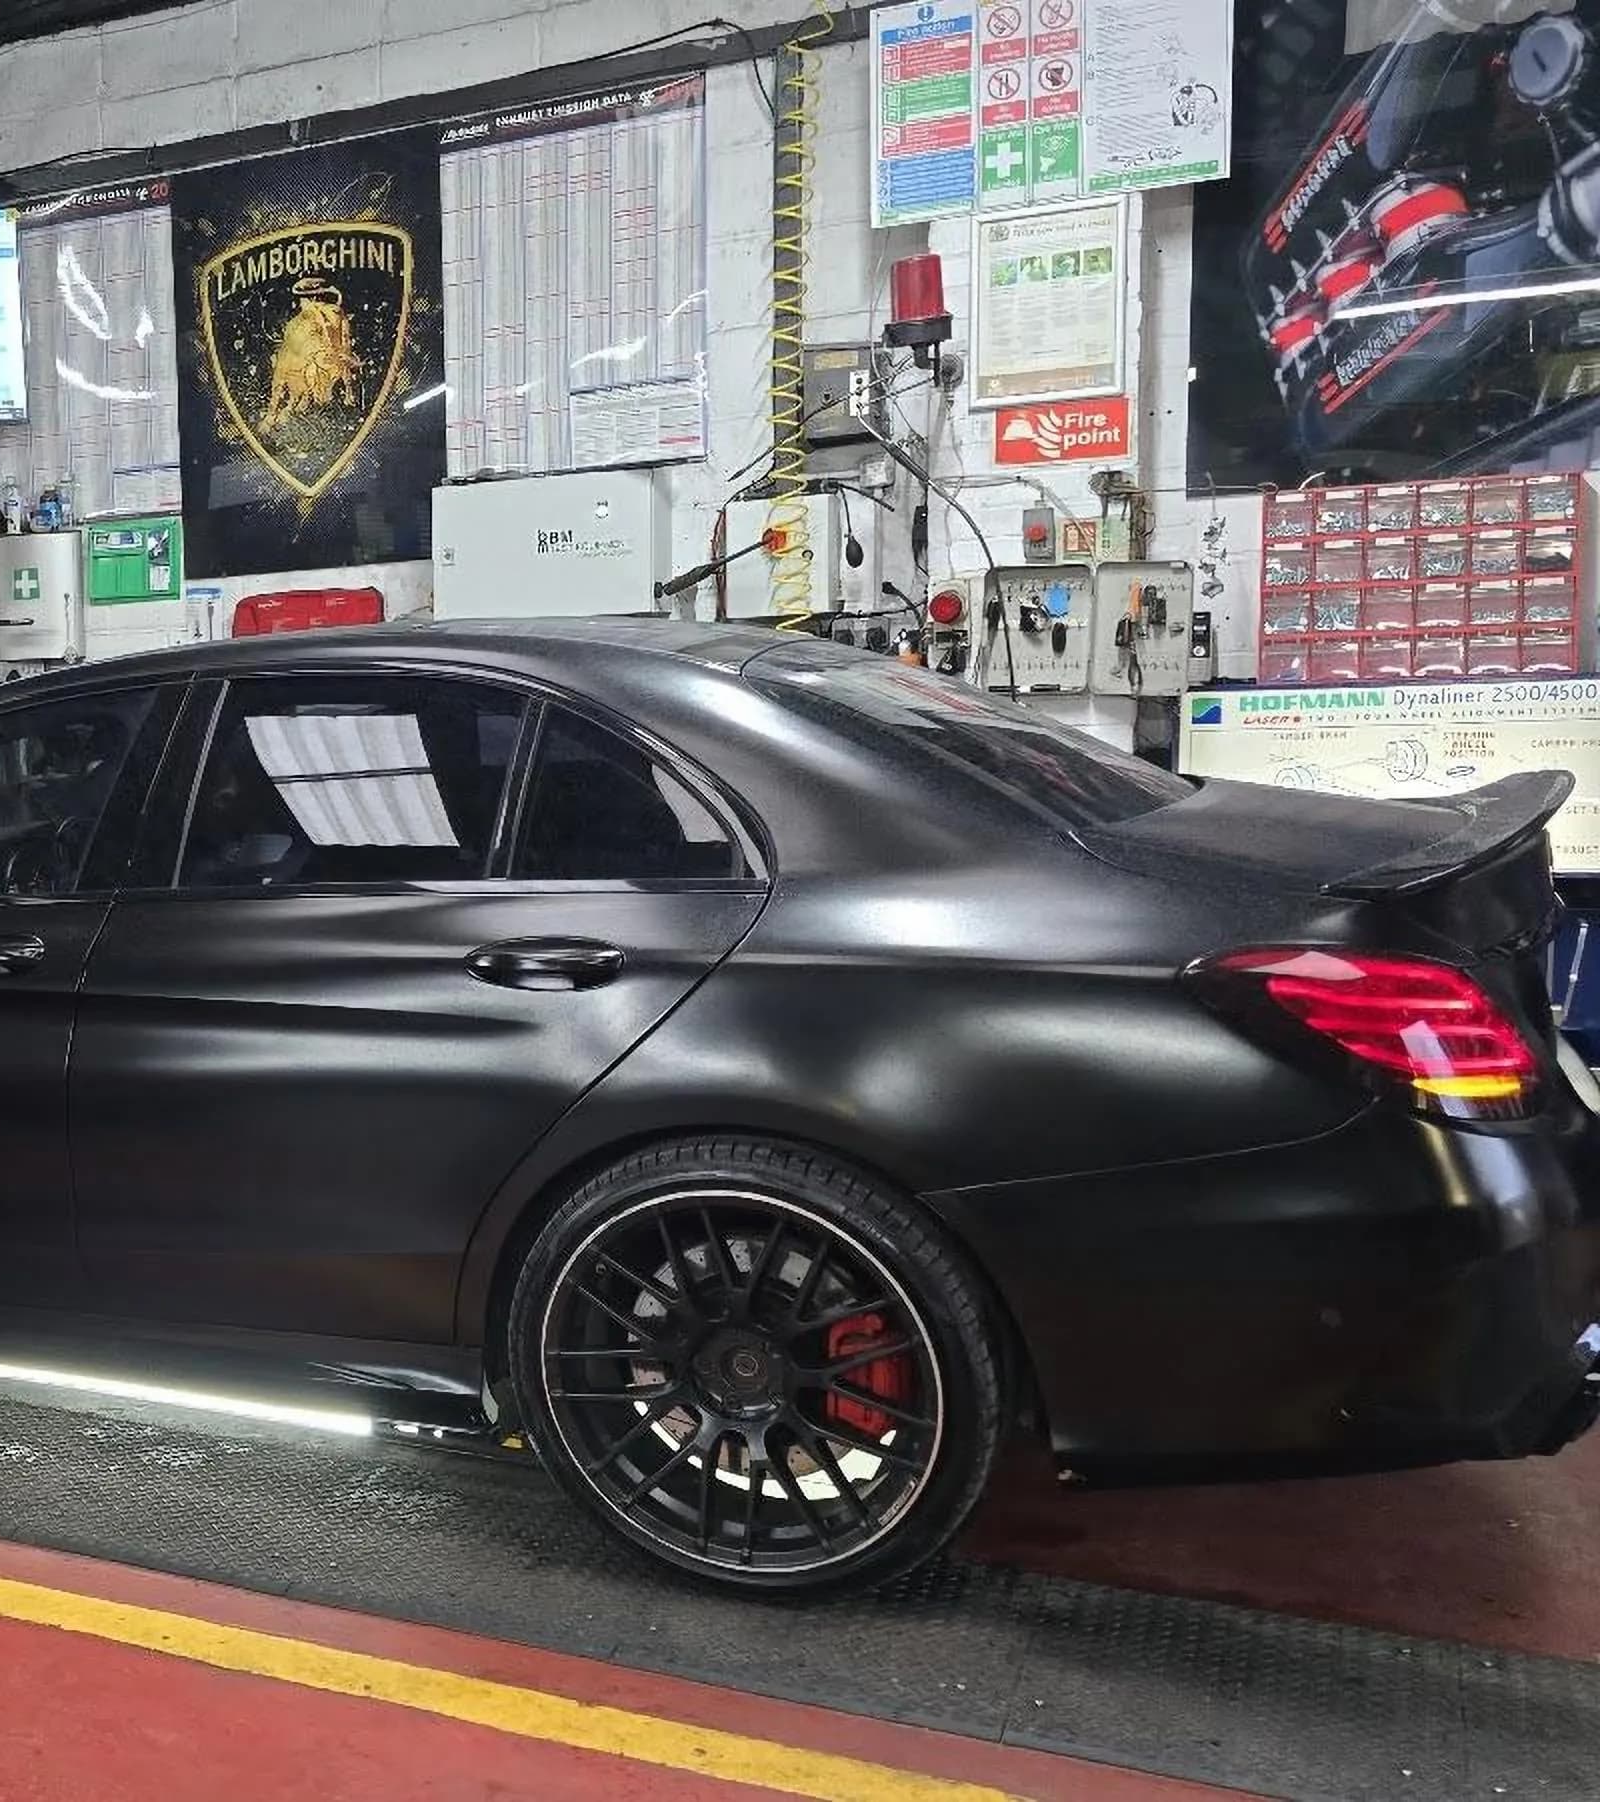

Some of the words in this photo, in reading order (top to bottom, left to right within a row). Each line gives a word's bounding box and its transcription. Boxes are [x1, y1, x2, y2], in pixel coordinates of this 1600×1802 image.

[216, 237, 395, 301] LAMBORGHINI
[1064, 412, 1107, 429] Fire
[1063, 426, 1121, 450] point
[1239, 692, 1386, 712] HOFMANN
[1393, 687, 1485, 710] Dynaliner
[1491, 684, 1598, 703] 2500/4500
